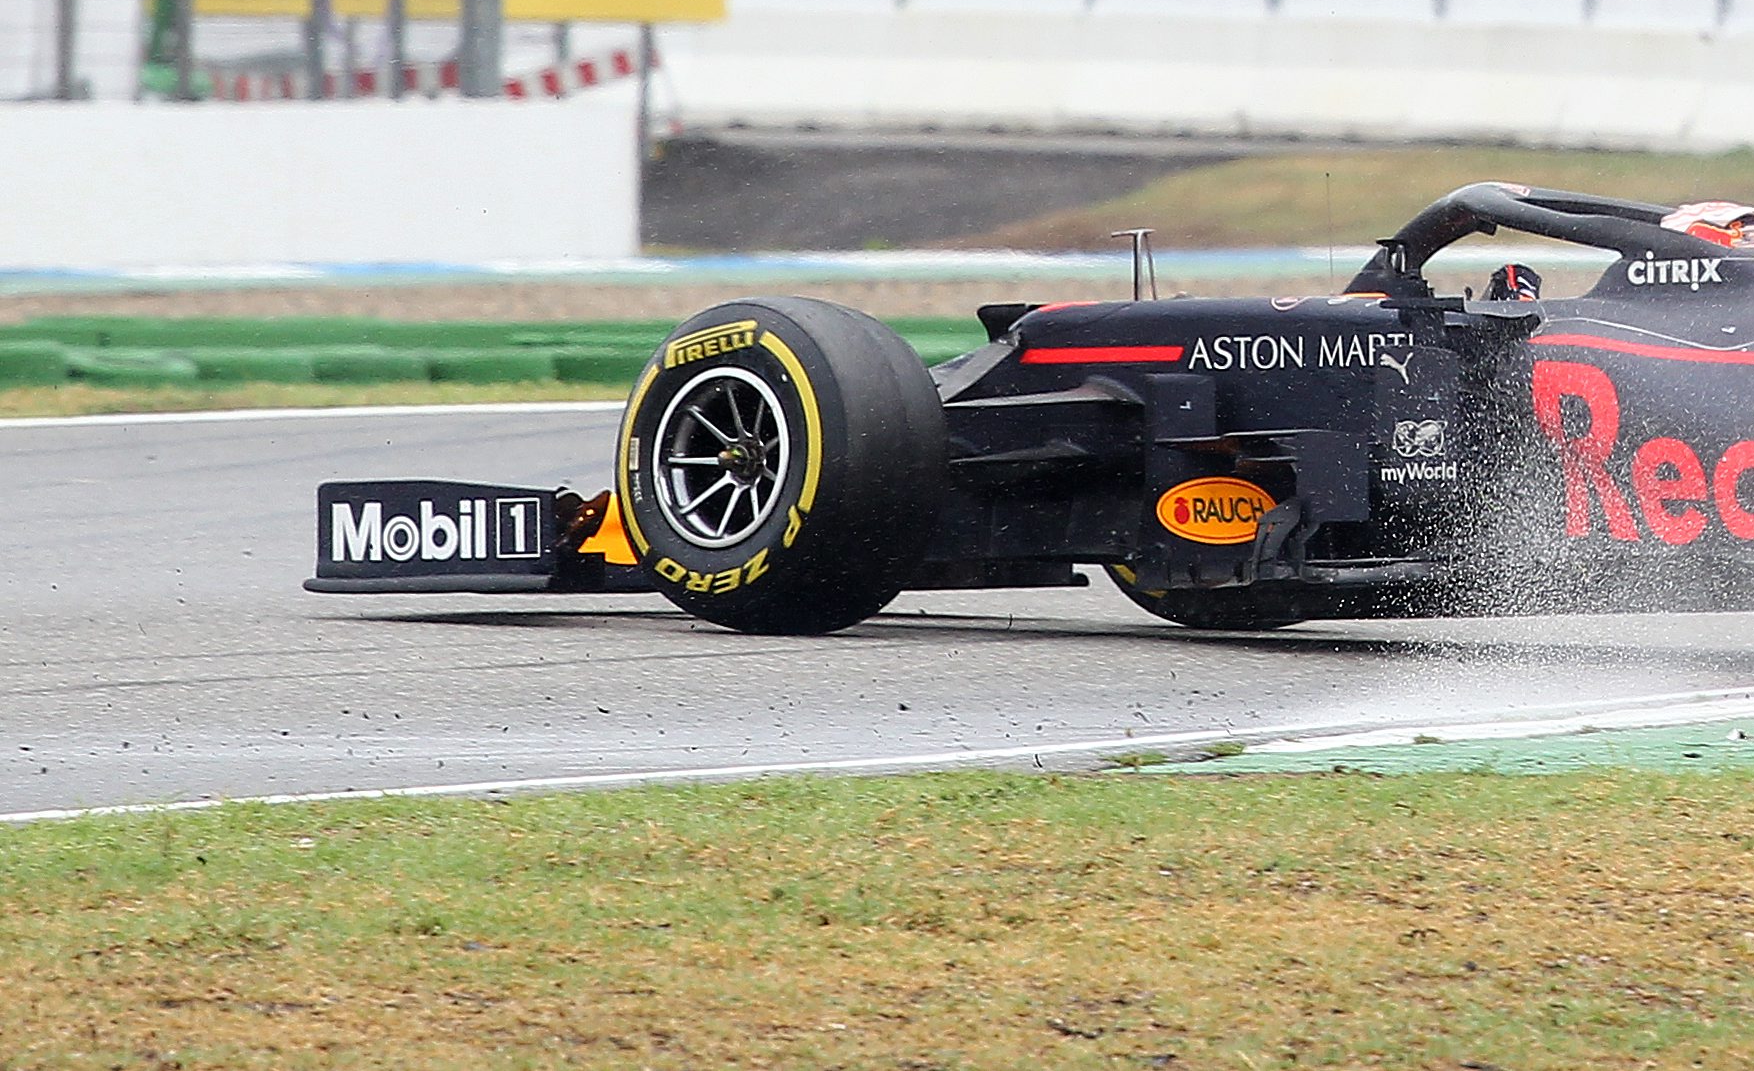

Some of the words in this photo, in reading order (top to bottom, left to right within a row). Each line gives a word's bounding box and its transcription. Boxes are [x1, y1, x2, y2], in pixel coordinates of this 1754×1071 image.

[664, 319, 758, 369] PIRELLI
[1188, 335, 1304, 369] ASTON
[1381, 462, 1457, 484] myWorld
[331, 499, 488, 562] Mobil
[510, 503, 525, 553] 1
[783, 505, 802, 548] P
[1193, 496, 1265, 524] RAUCH
[654, 547, 770, 595] ZERO
